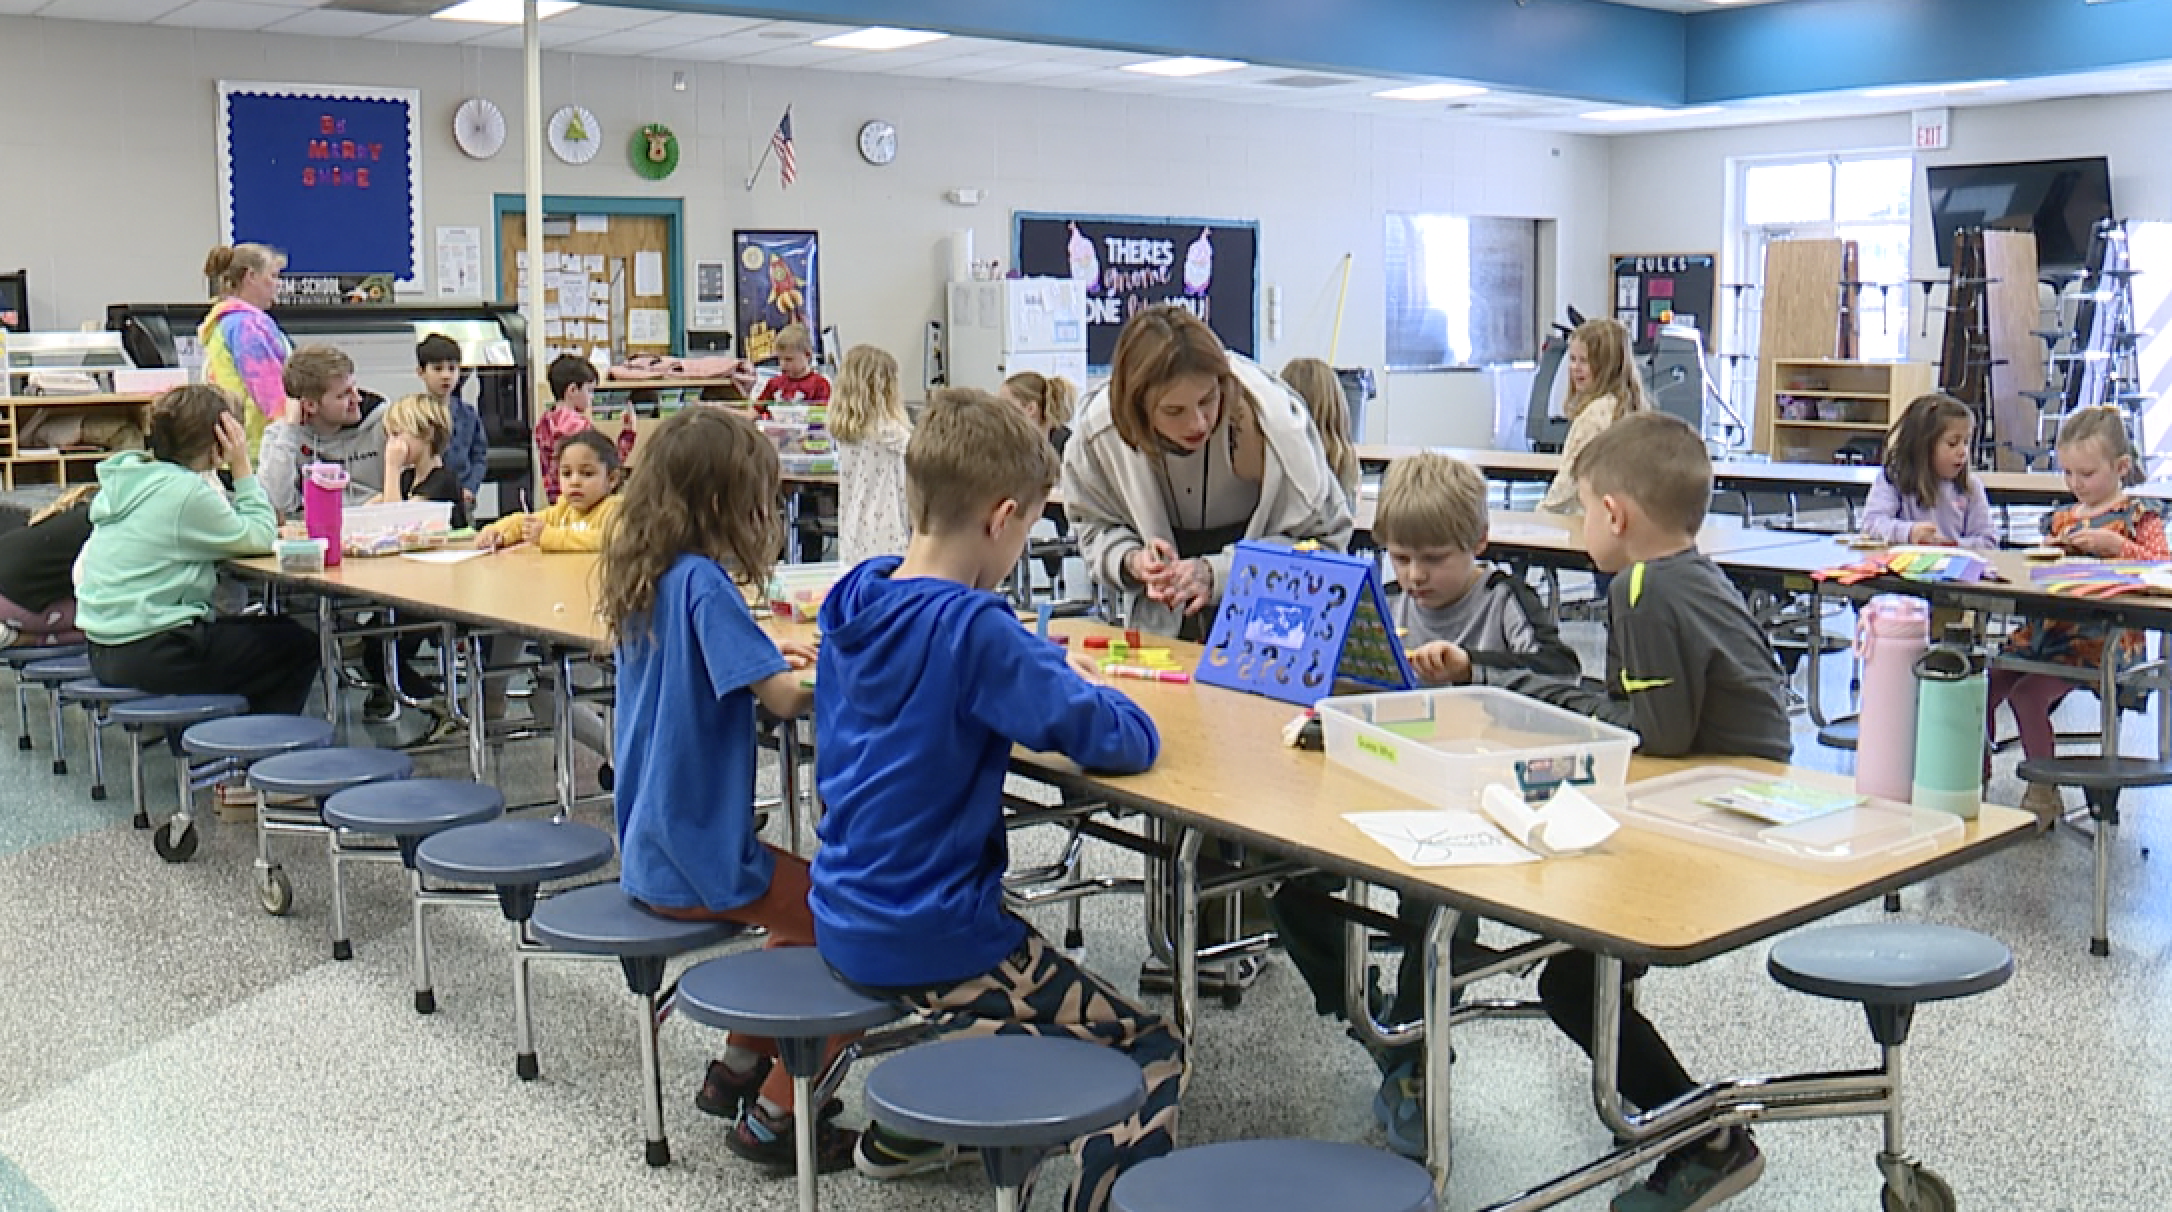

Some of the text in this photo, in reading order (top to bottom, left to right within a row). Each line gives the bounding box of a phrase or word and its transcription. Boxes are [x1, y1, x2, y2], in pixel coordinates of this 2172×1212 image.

[1916, 125, 1943, 147] EXIT
[1635, 256, 1687, 273] RULES
[1086, 297, 1122, 325] ONE
